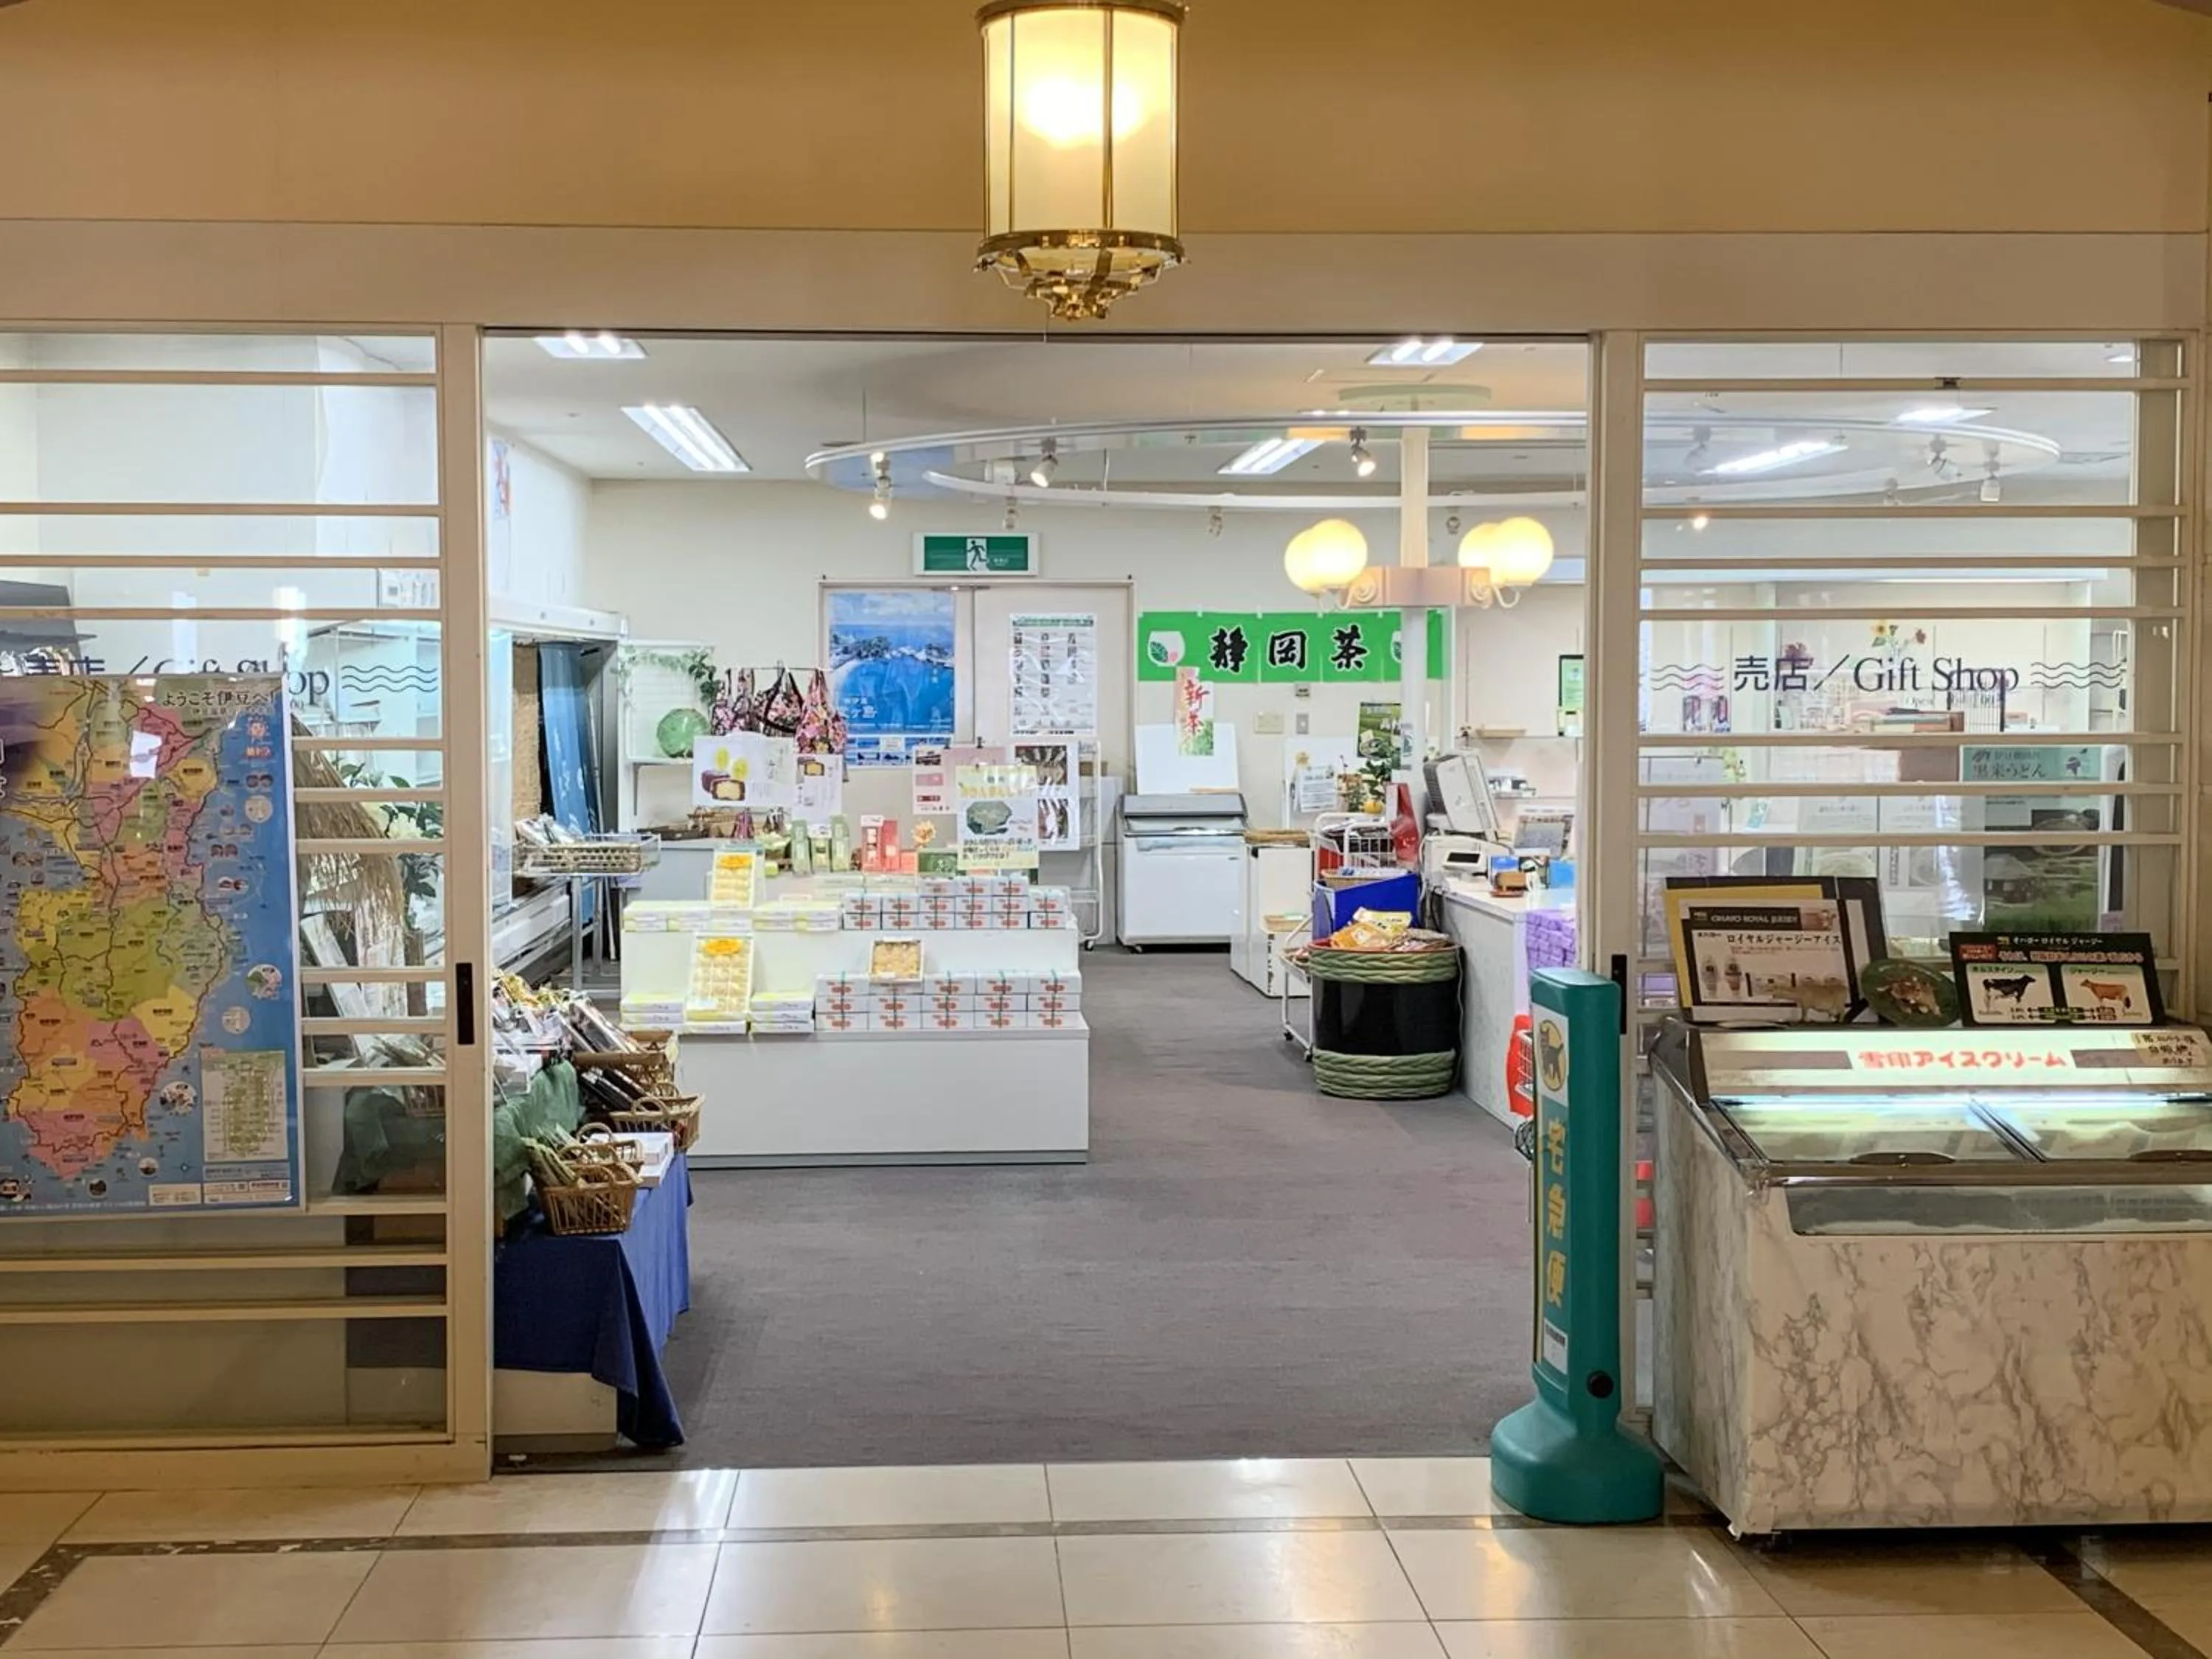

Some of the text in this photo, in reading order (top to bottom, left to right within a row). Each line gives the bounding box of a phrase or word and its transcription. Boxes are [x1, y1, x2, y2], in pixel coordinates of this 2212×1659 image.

[1208, 625, 1368, 672] 静岡茶
[1932, 657, 2020, 701] Shop
[1859, 1050, 2067, 1069] 雪印アイスクリーム
